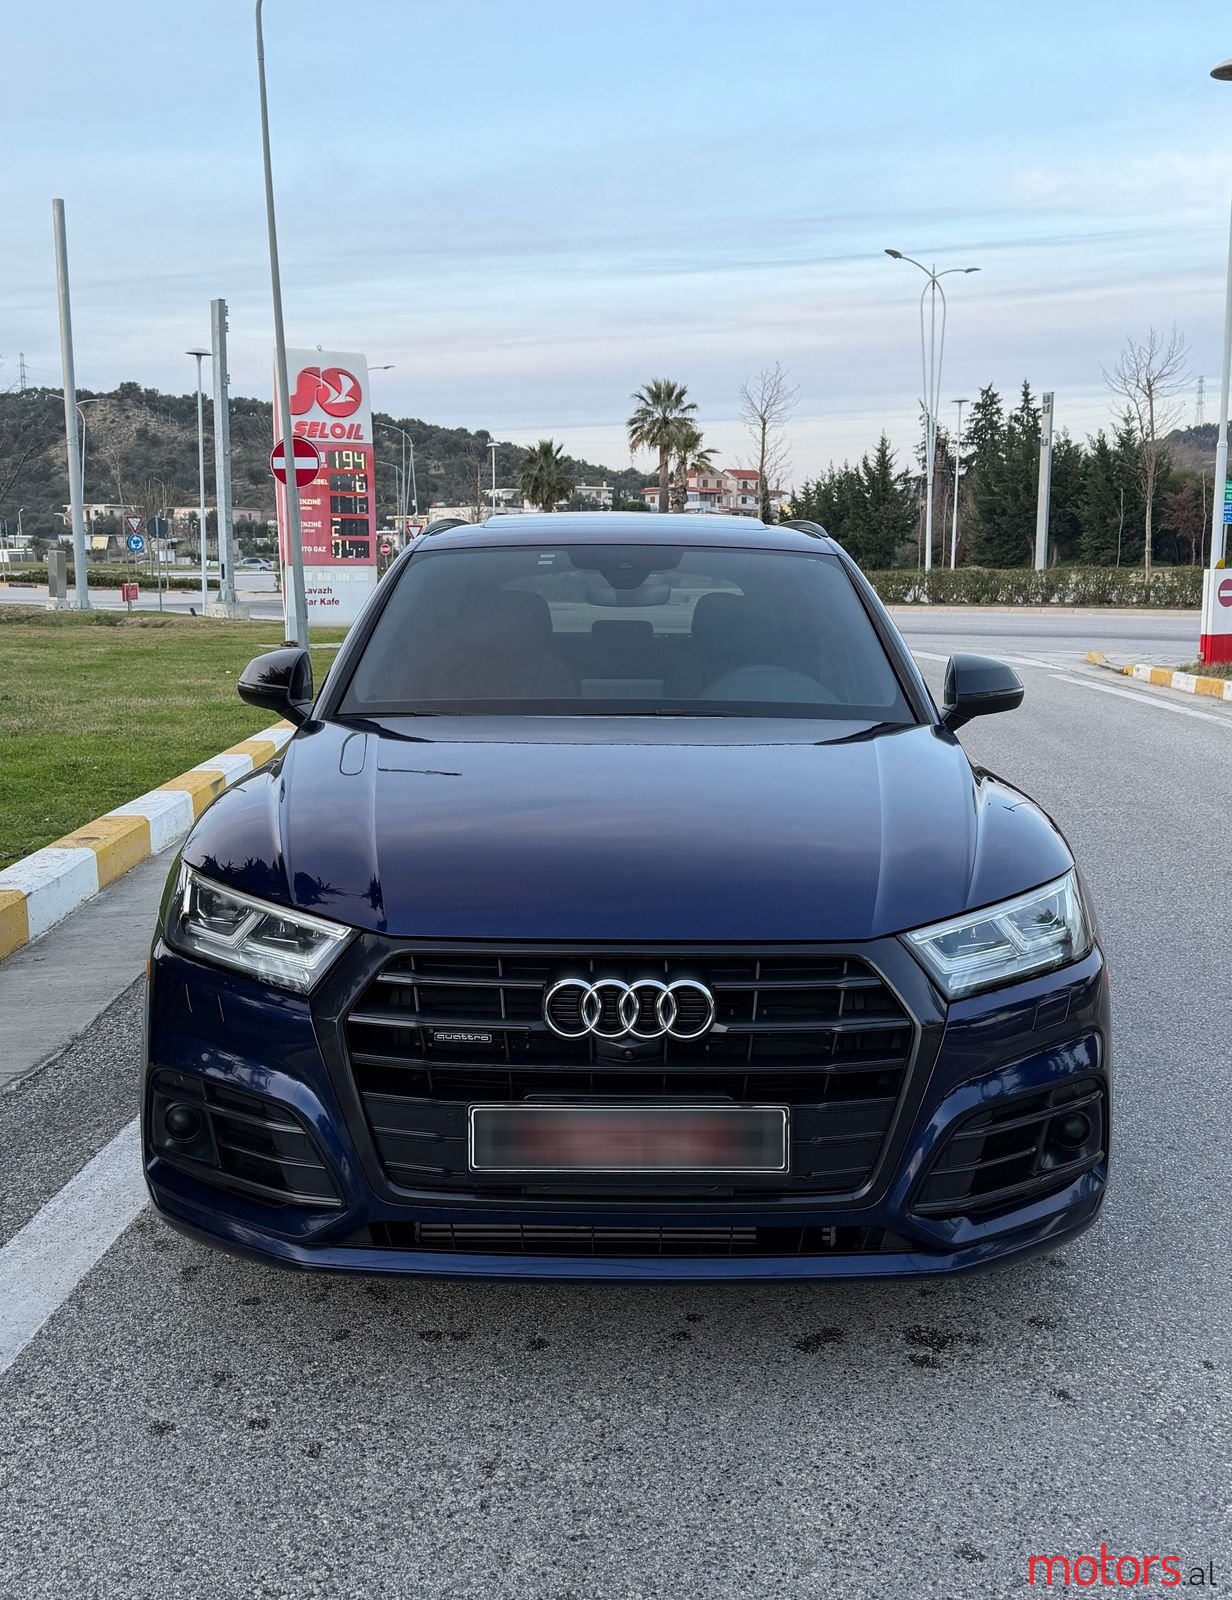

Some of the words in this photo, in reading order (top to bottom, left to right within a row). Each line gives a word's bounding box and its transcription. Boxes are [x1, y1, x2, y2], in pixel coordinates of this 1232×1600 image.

[293, 421, 364, 440] SELOIL
[335, 450, 365, 470] 194
[299, 497, 321, 506] ENZINË
[319, 597, 340, 606] Kafe
